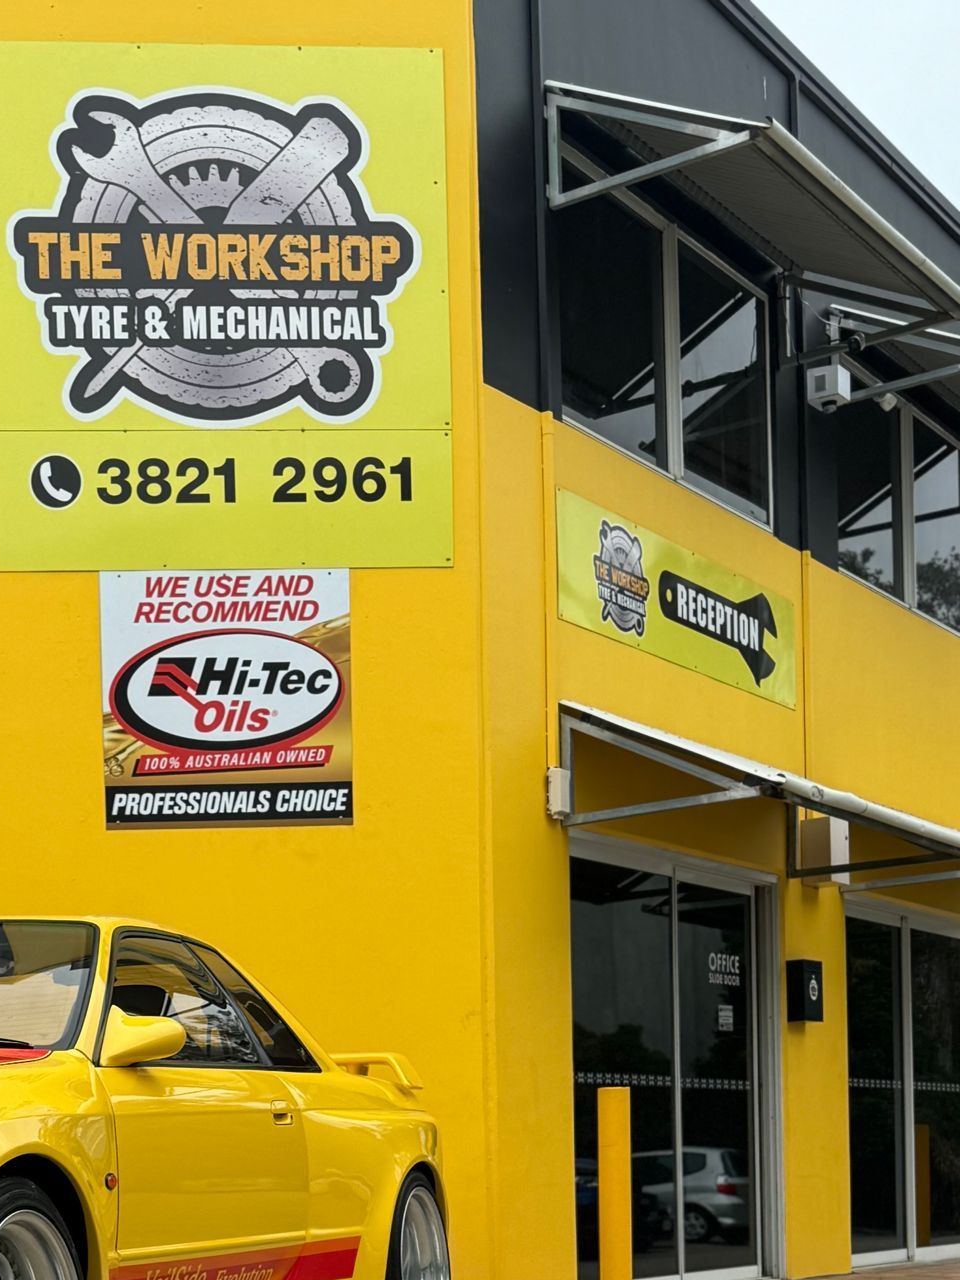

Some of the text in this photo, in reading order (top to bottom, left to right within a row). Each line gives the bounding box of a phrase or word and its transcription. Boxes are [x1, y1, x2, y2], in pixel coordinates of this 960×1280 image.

[28, 232, 401, 282] THE WORKSHOP
[52, 305, 379, 341] TYRE & MECHANICAL
[96, 456, 413, 504] 3821 2961
[144, 574, 315, 599] WE USE AND
[133, 600, 320, 624] RECOMMEND
[676, 582, 760, 651] RECEPTION
[195, 656, 333, 696] Hi-Tec
[194, 699, 271, 734] Oils
[143, 748, 327, 771] 100% AUSTRALIAN OWNED
[111, 788, 350, 816] PROFESSIONALS CHOICE
[708, 951, 740, 974] OFFICE
[724, 974, 740, 987] DOOR
